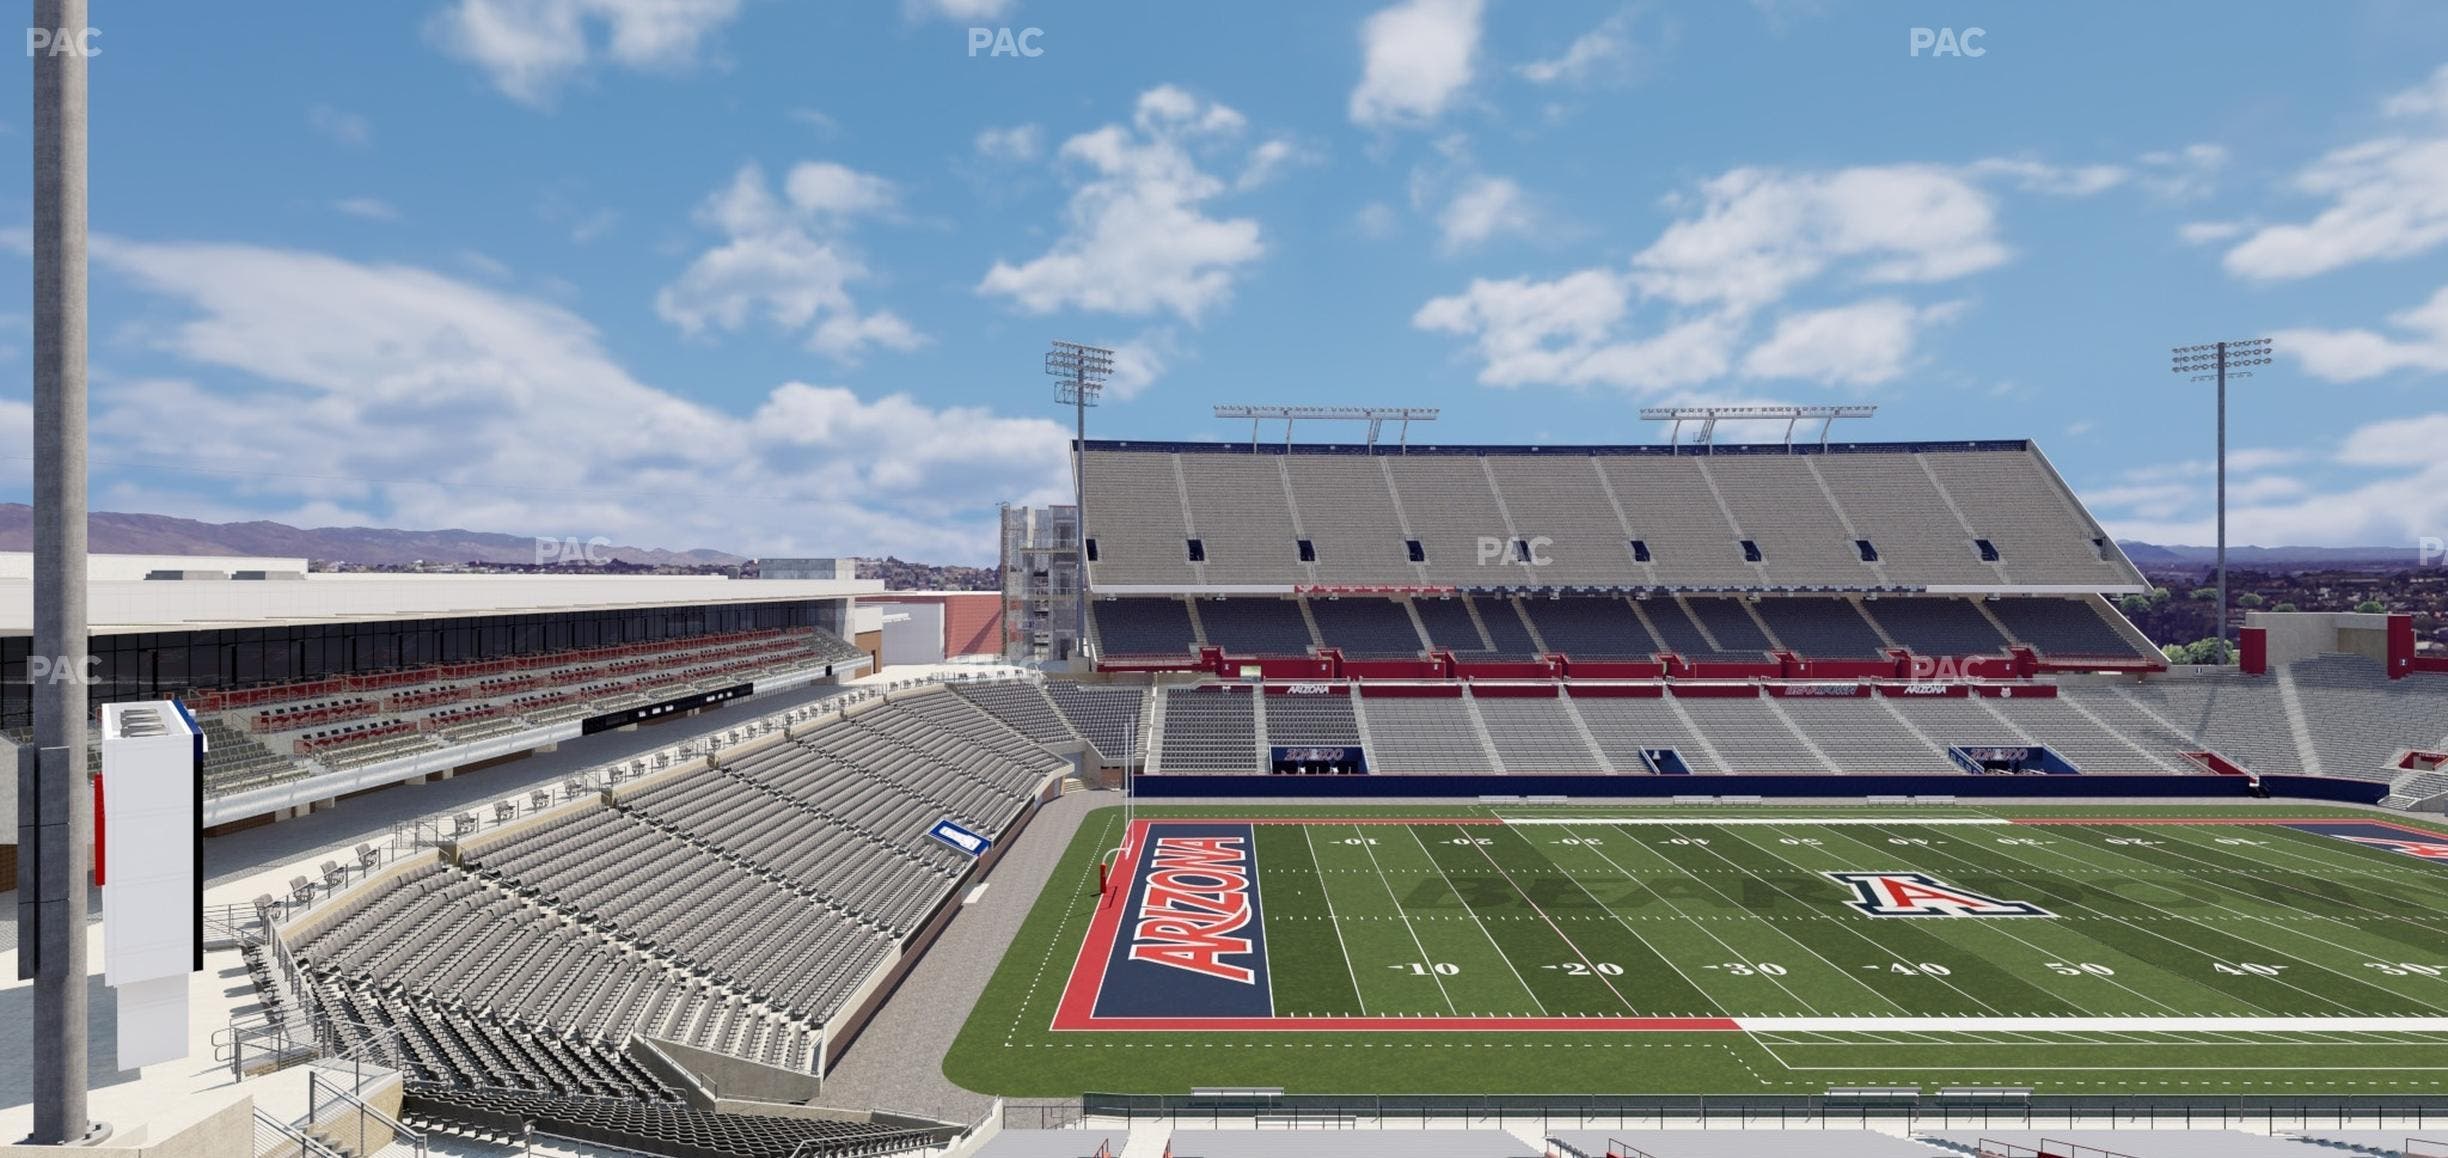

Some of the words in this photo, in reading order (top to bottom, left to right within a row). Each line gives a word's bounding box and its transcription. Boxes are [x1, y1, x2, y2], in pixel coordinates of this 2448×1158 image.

[1286, 685, 1330, 694] ARIZONA
[1903, 684, 1947, 694] ARIZONA
[1129, 837, 1256, 985] ARIZONA
[1406, 963, 1460, 976] 10
[1562, 963, 1624, 976] 20
[1723, 963, 1788, 976] 30
[1890, 963, 1951, 976] 40
[2044, 963, 2115, 976] 50
[2213, 963, 2281, 976] 40
[2363, 963, 2443, 976] 30
